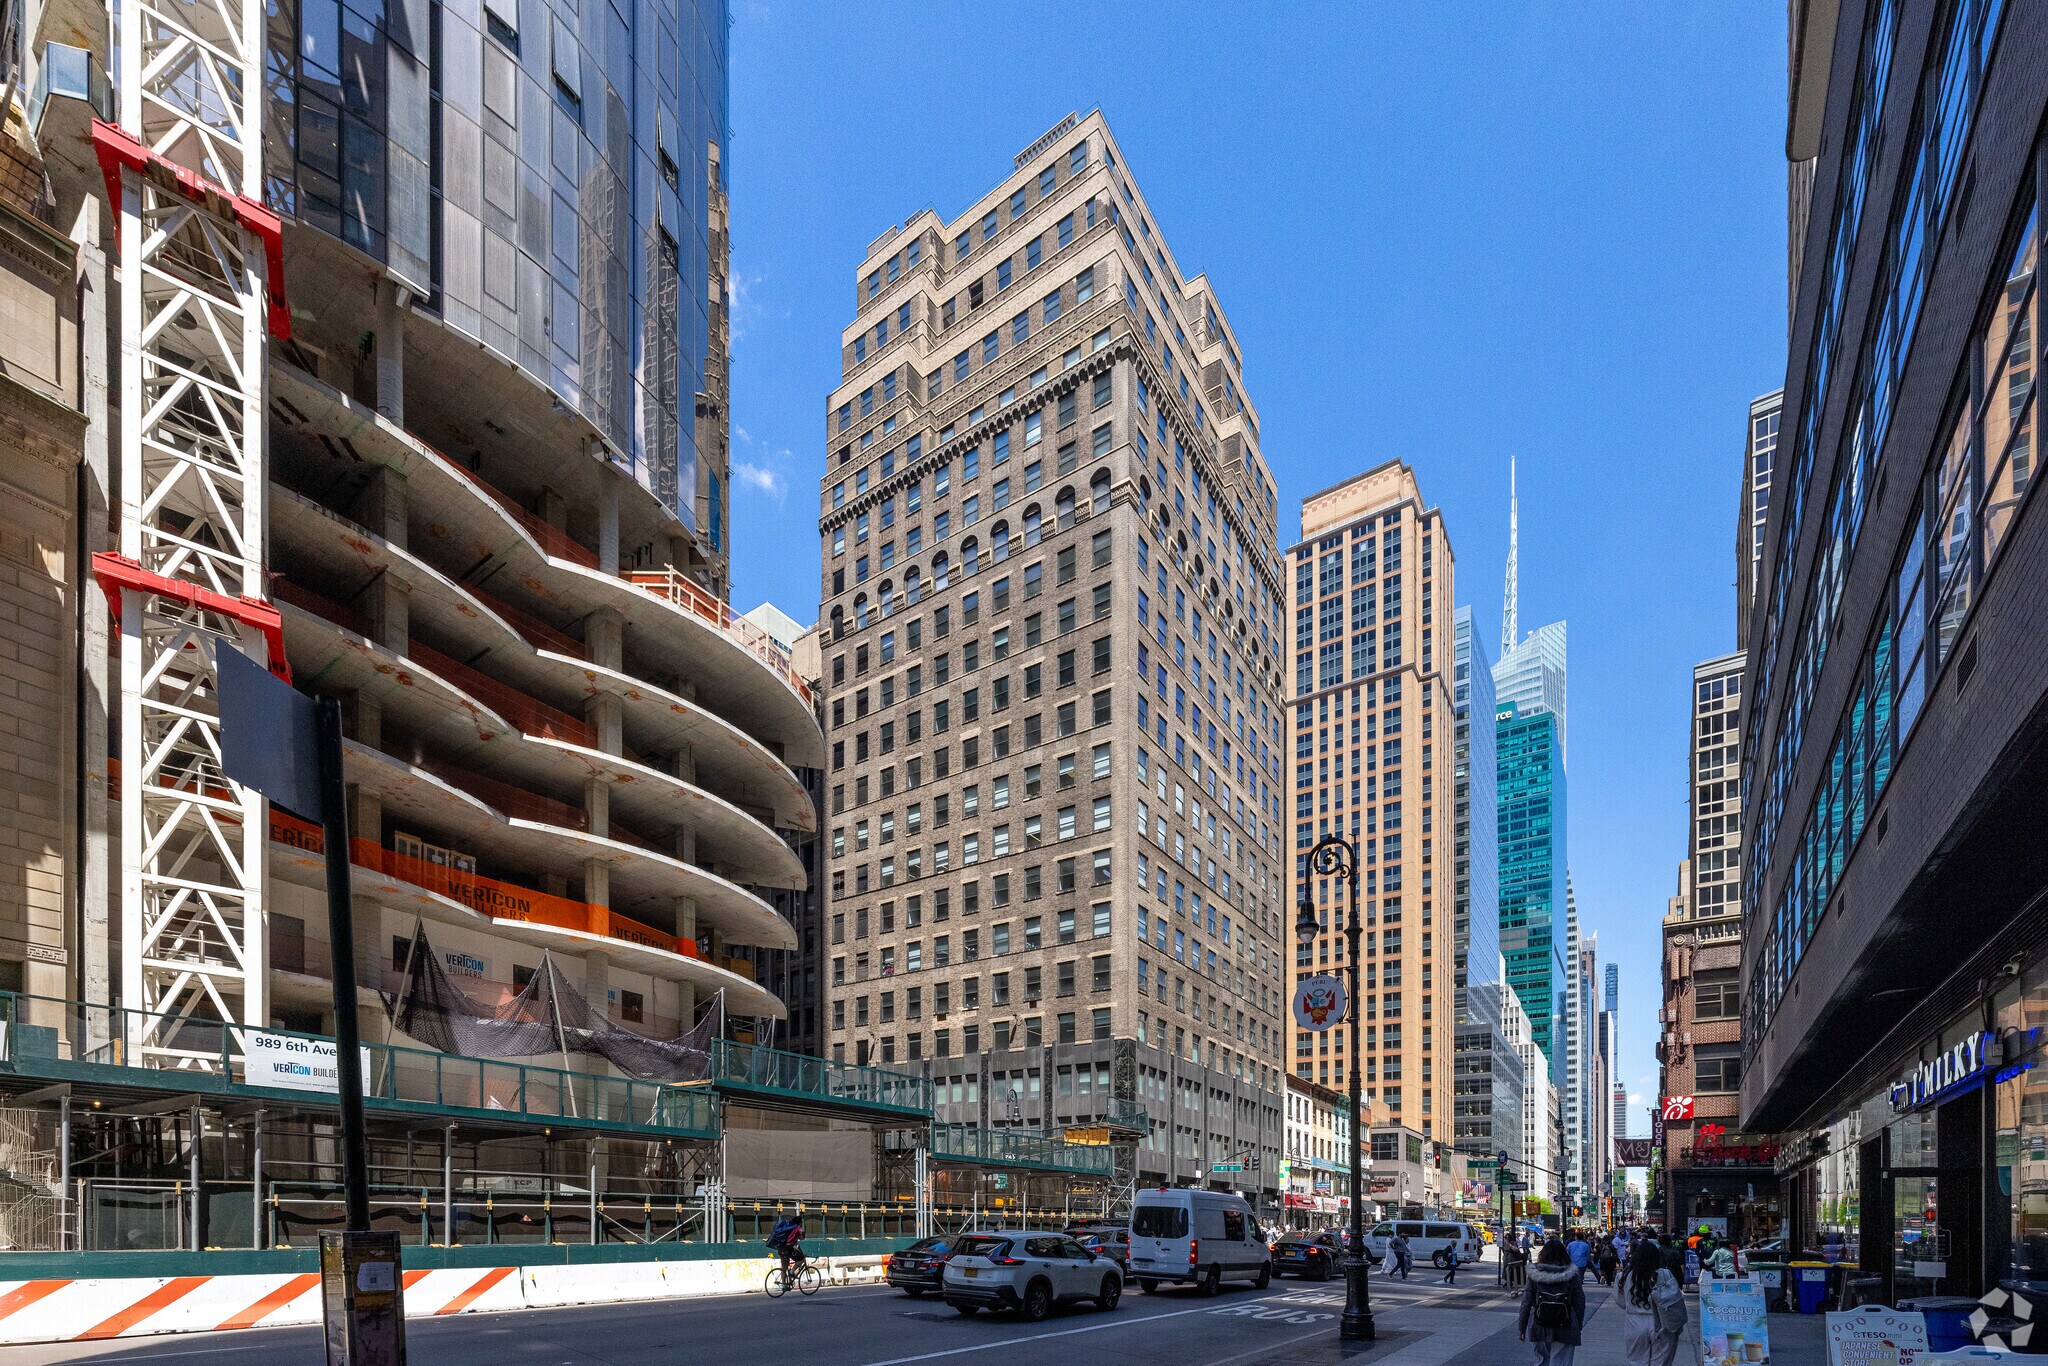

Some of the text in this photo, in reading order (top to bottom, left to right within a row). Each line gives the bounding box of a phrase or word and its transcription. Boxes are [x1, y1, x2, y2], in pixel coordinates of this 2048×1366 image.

[1496, 710, 1513, 721] rce
[448, 880, 531, 913] VERTCON
[445, 953, 484, 972] VERTCON
[448, 964, 483, 979] BUILDERS
[1311, 979, 1329, 987] PERU
[255, 1037, 337, 1057] 989 6th Ave
[273, 1061, 338, 1079] VERTCON BUILDE
[1912, 1031, 1980, 1105] I'MILKY
[1655, 1110, 1664, 1146] LIQUOR
[1614, 1141, 1652, 1159] M&J
[1206, 1304, 1336, 1324] BUS
[1707, 1306, 1762, 1315] COCONUT
[1861, 1331, 1887, 1339] TESO
[1841, 1341, 1882, 1350] JAPANESE
[1842, 1351, 1895, 1359] CONVENIENT
[1899, 1357, 1914, 1366] OP
